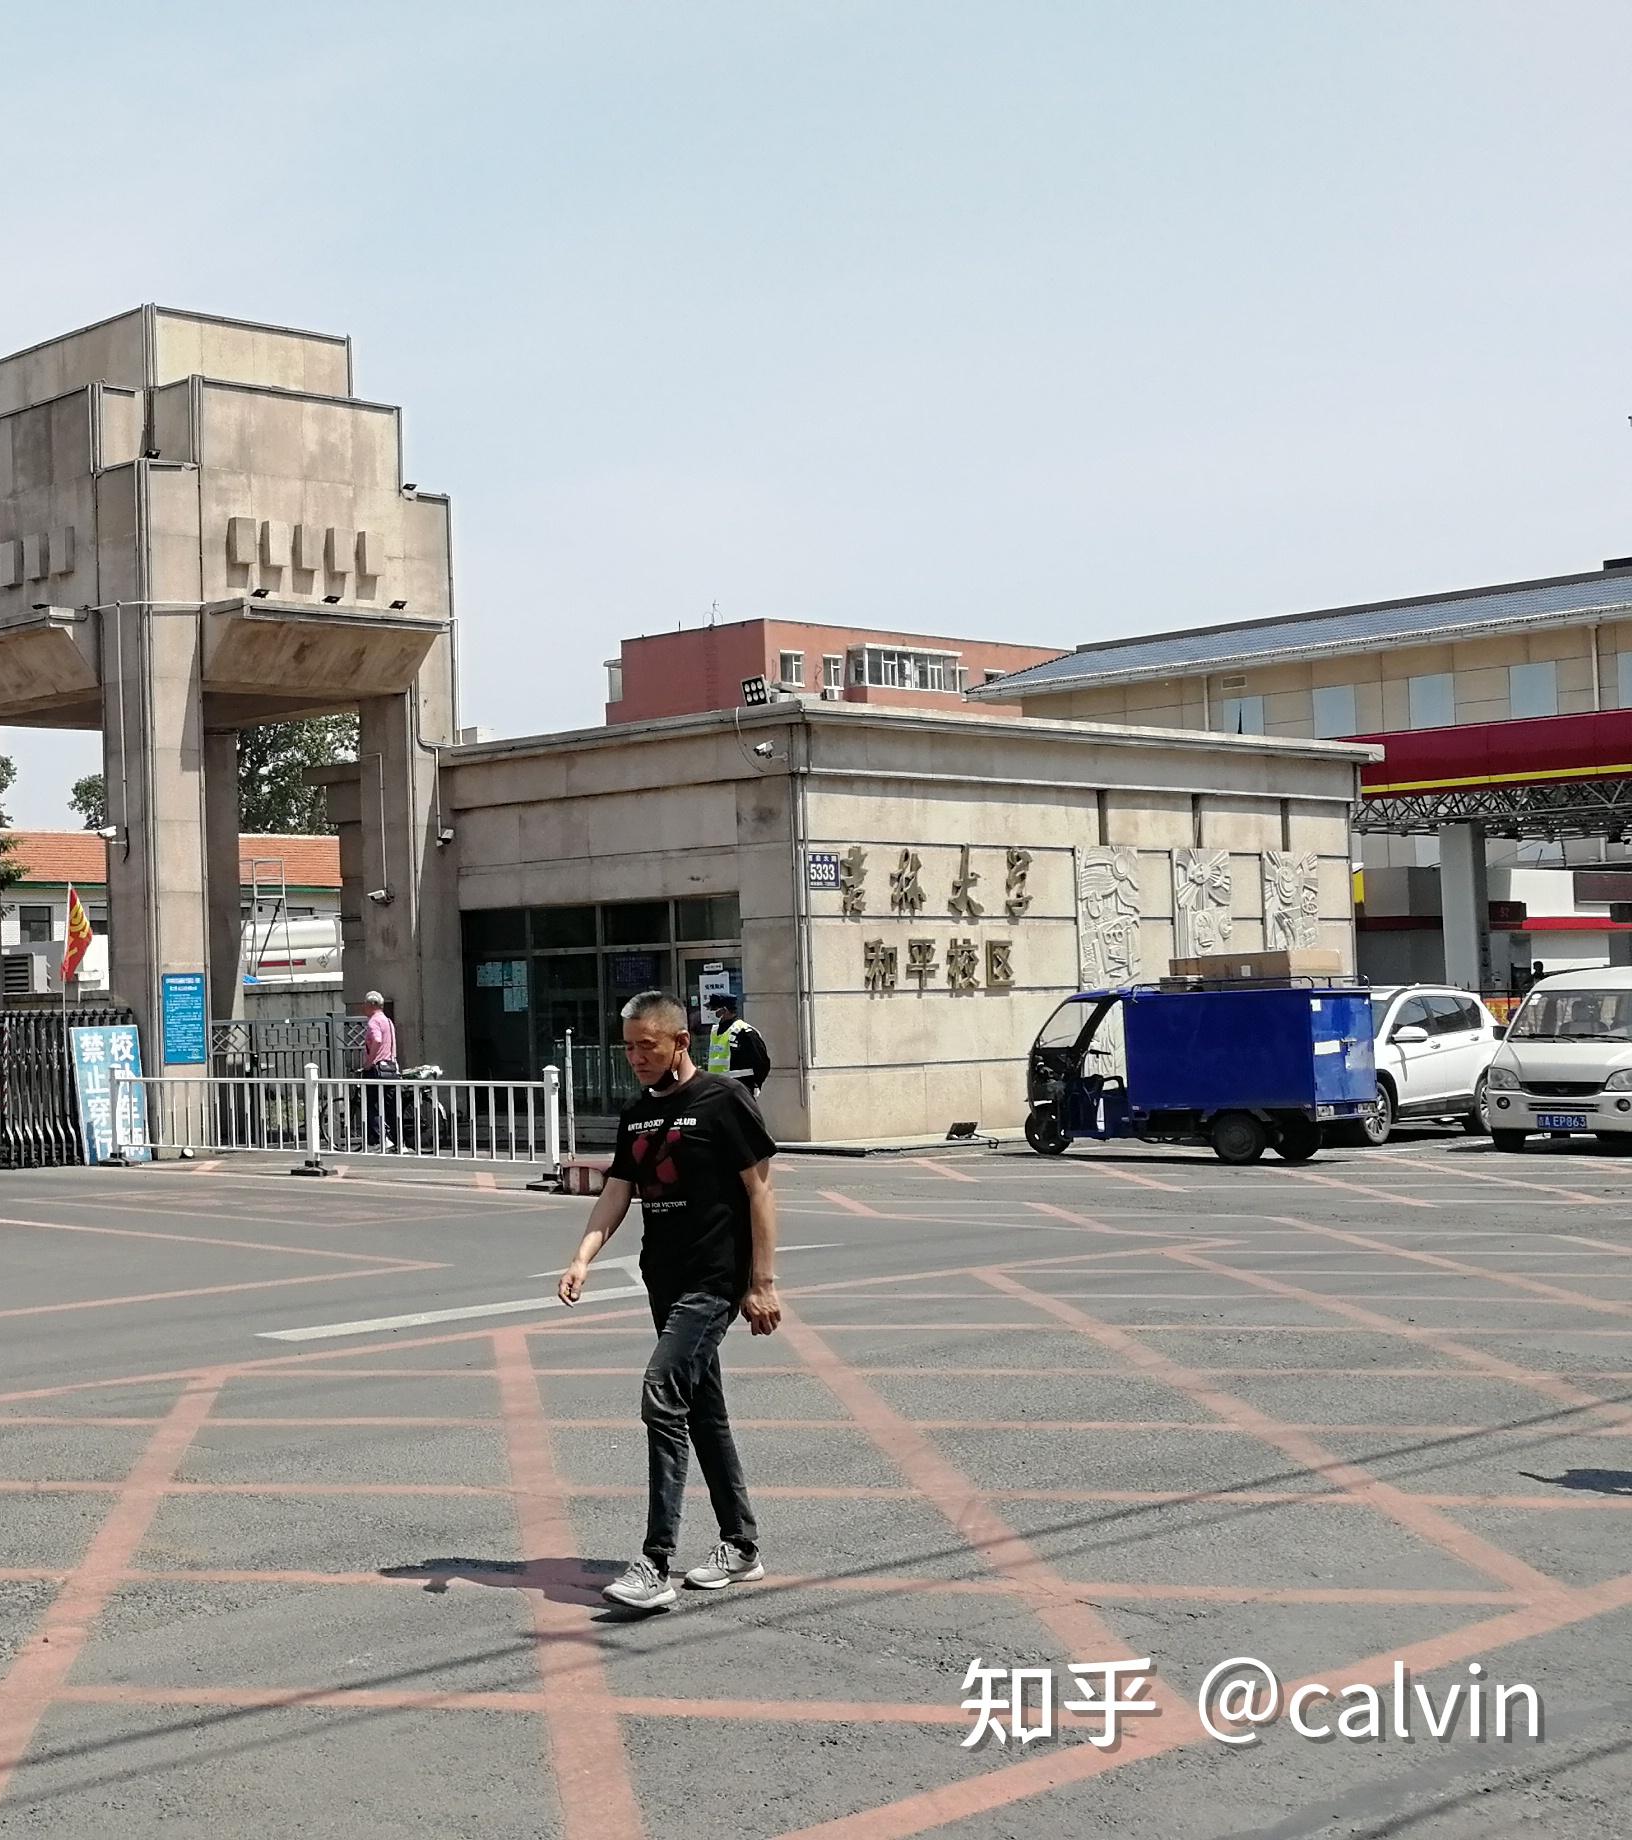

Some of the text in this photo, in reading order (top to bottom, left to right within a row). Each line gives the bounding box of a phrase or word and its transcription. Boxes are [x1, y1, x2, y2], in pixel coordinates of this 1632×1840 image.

[810, 863, 835, 880] 5333
[864, 938, 1015, 991] 和平校区
[79, 1033, 113, 1160] 禁止穿行
